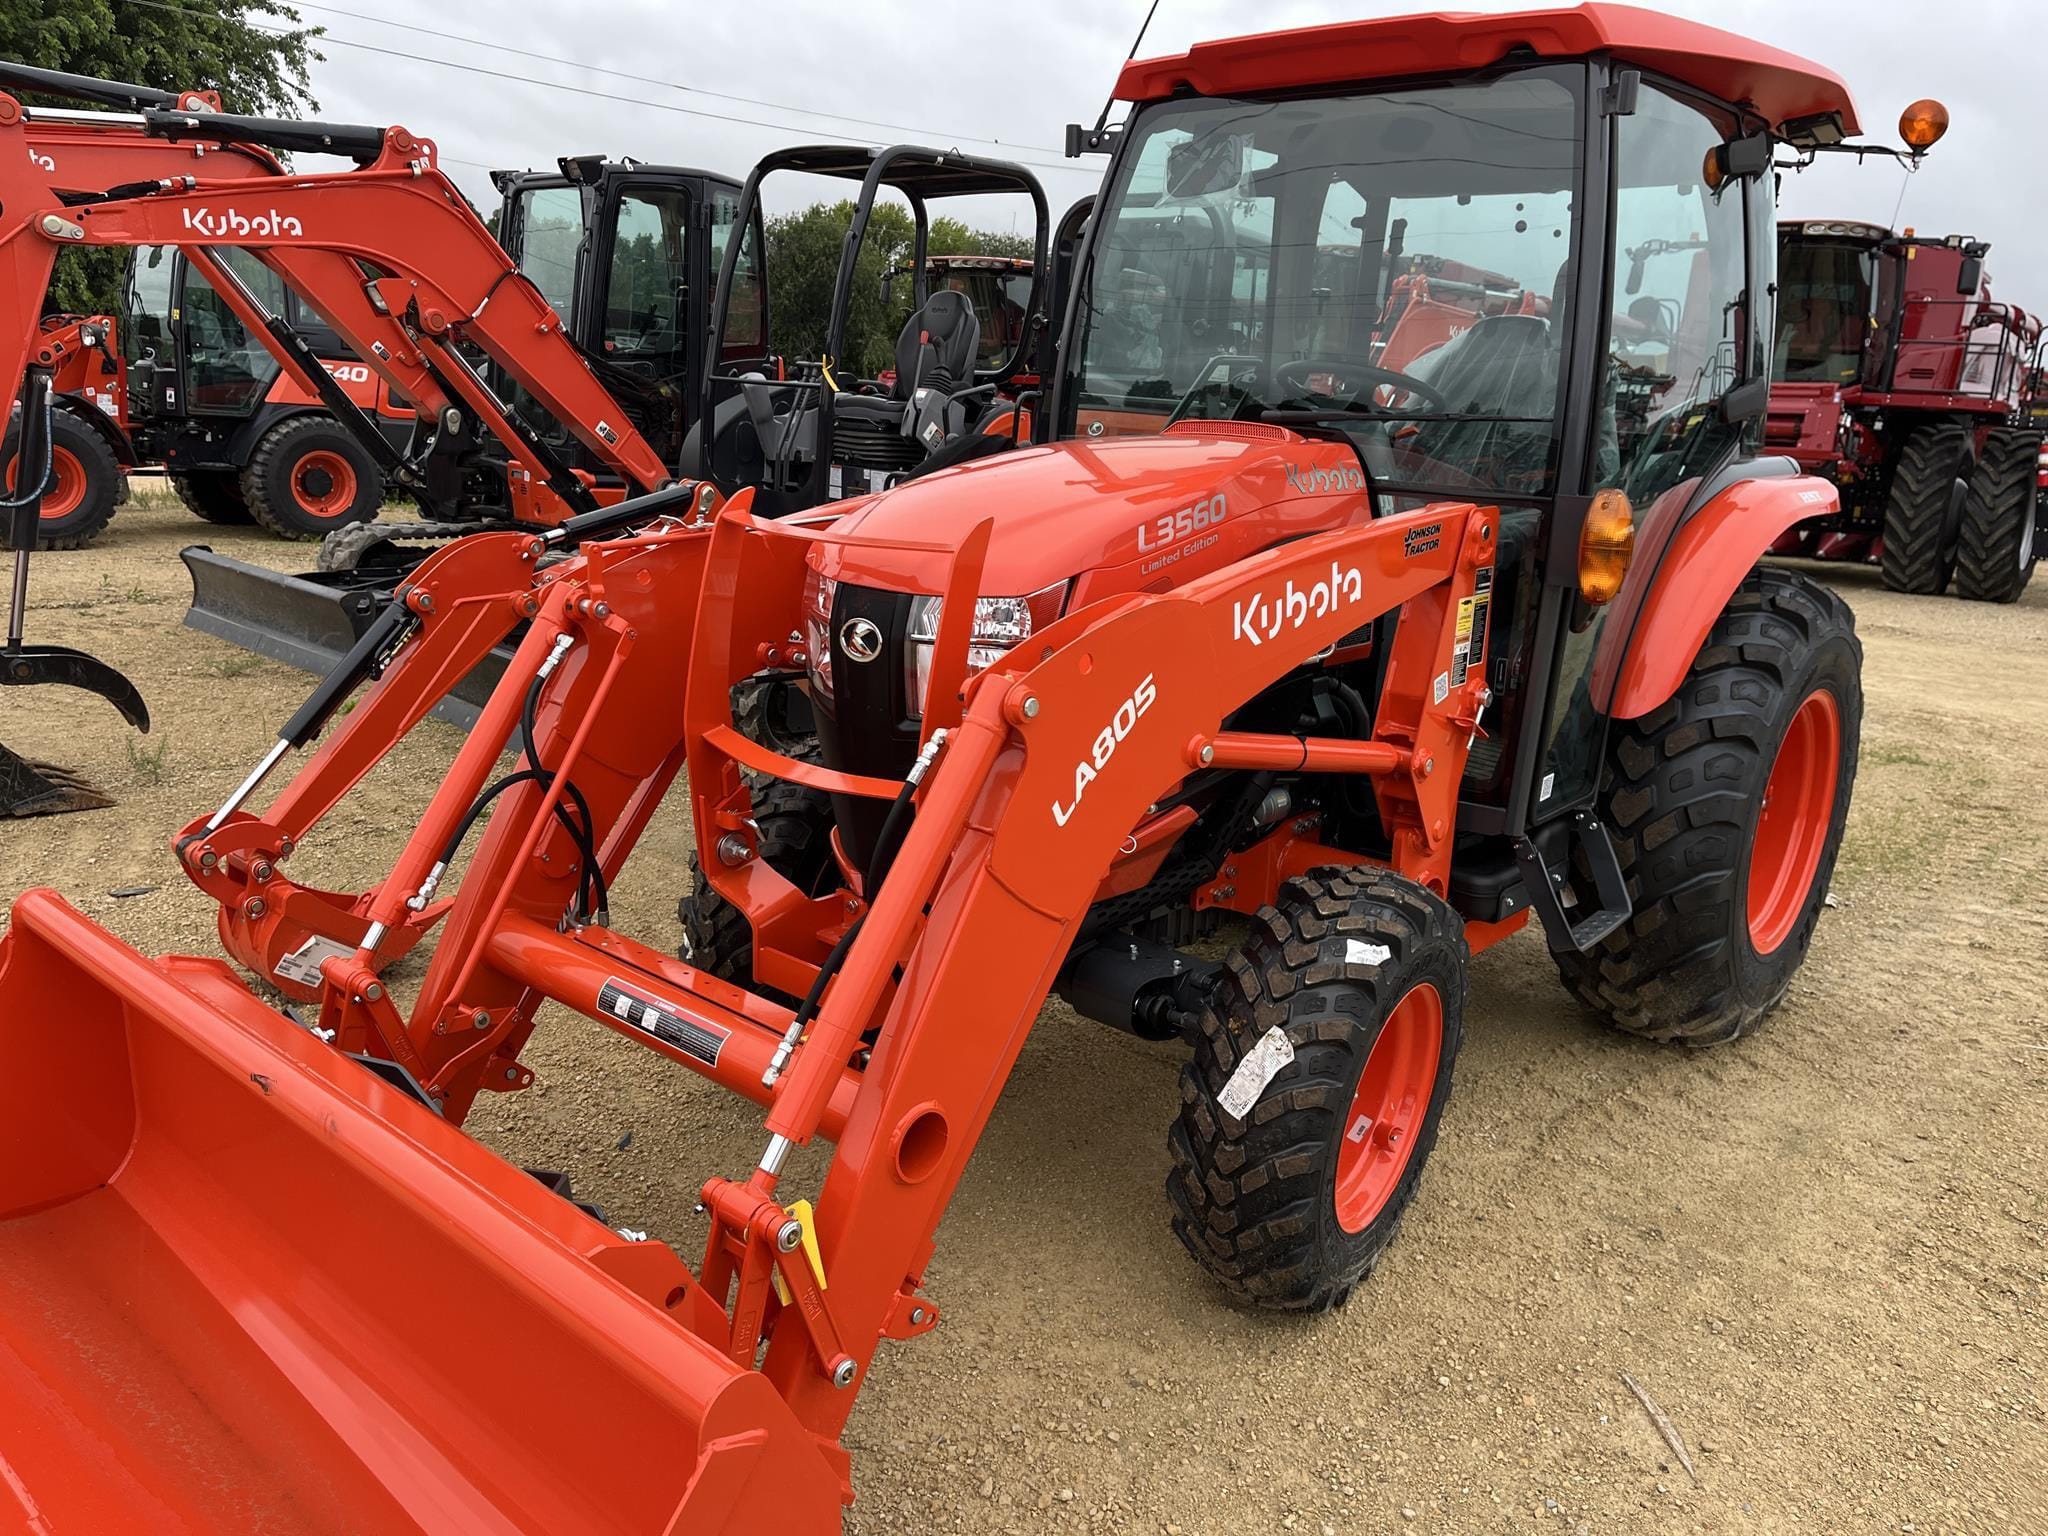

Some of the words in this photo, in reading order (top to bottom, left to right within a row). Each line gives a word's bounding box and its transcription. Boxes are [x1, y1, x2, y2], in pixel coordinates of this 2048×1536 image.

[182, 208, 303, 236] Kubota
[1284, 462, 1363, 494] Kubota
[1137, 493, 1227, 554] L3560
[1404, 523, 1442, 543] JOHNSON
[1141, 551, 1181, 576] Limited
[1183, 533, 1219, 555] Edition
[1404, 538, 1440, 558] TRACTOR
[1233, 561, 1362, 646] Kubota
[1052, 672, 1157, 827] LA805
